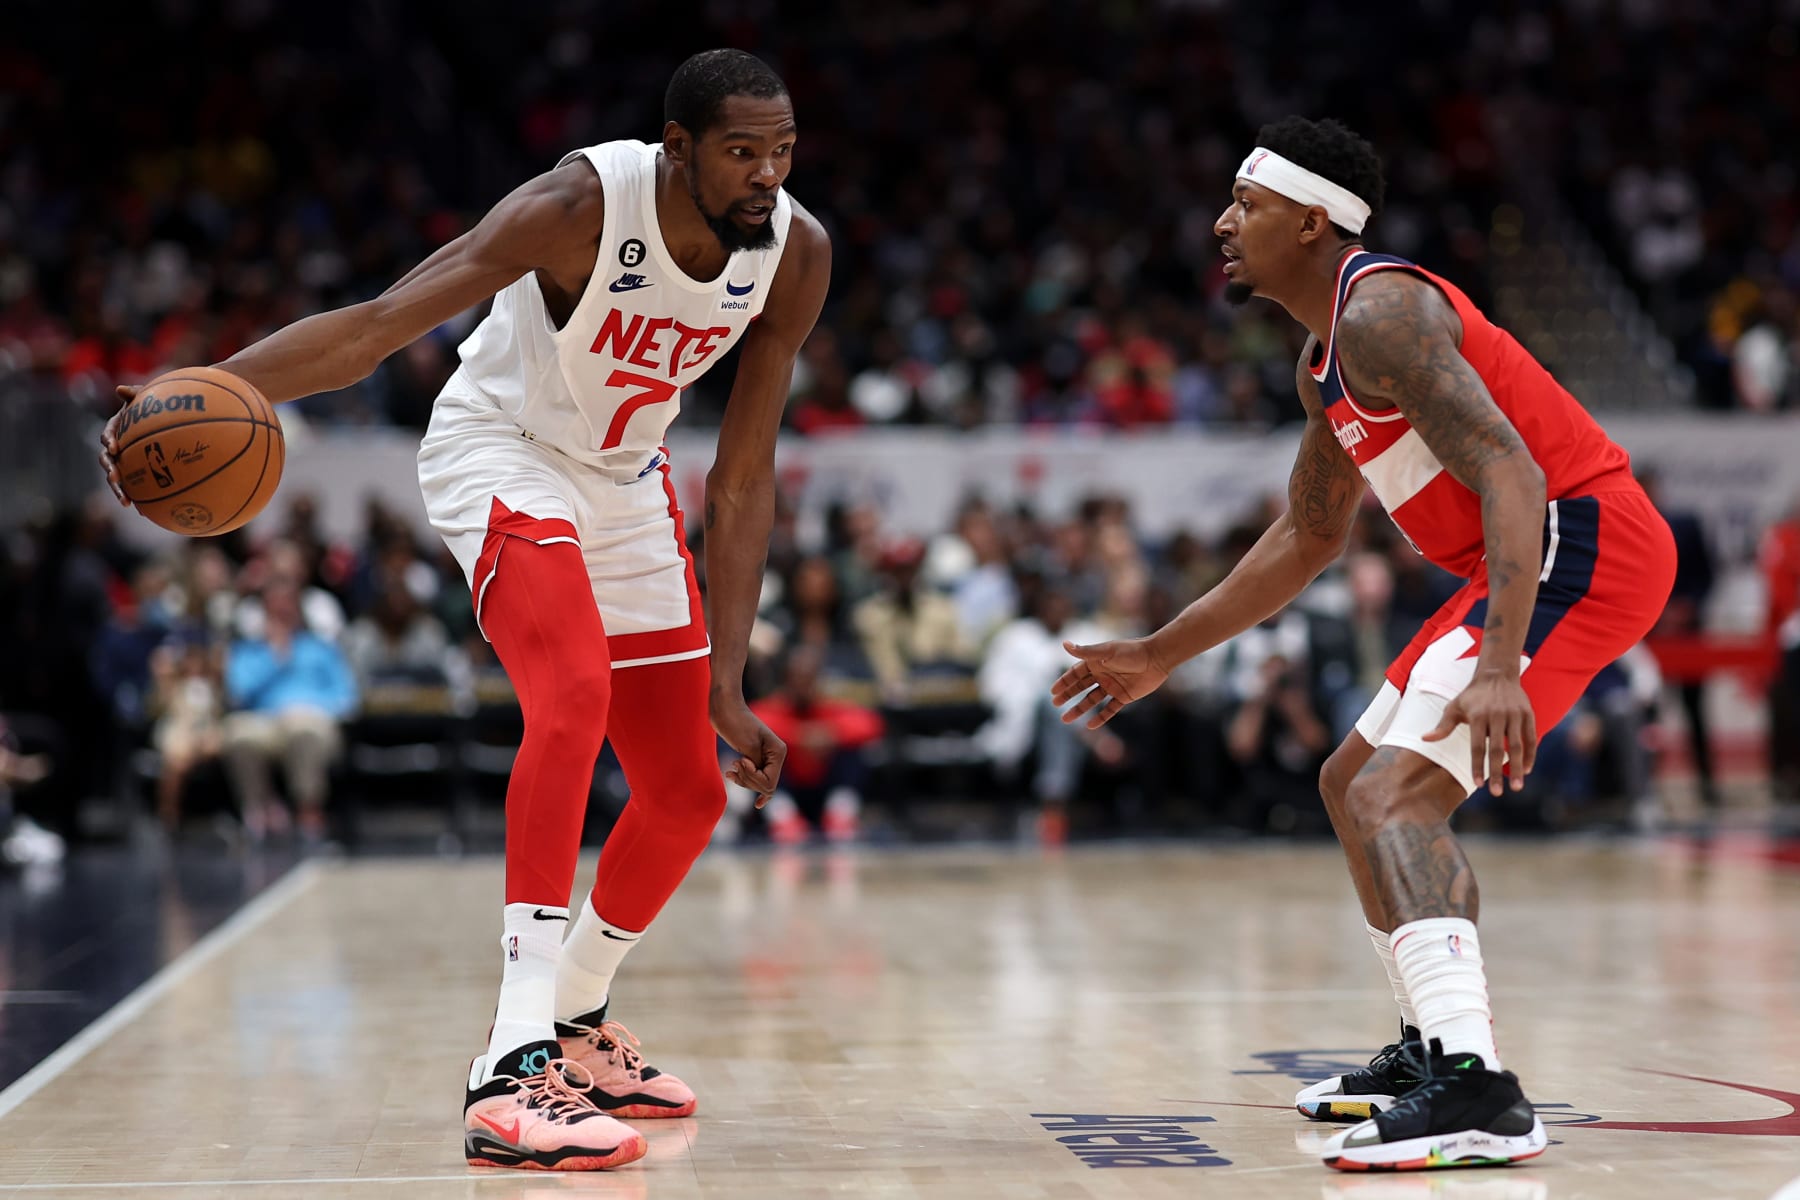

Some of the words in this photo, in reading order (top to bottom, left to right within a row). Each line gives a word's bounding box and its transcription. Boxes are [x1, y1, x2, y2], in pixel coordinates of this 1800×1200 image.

[623, 243, 640, 264] 6
[617, 272, 647, 286] NIKE
[721, 301, 749, 310] Webull
[589, 307, 731, 379] NETS
[600, 369, 679, 450] 7
[1029, 1113, 1234, 1169] Arena
